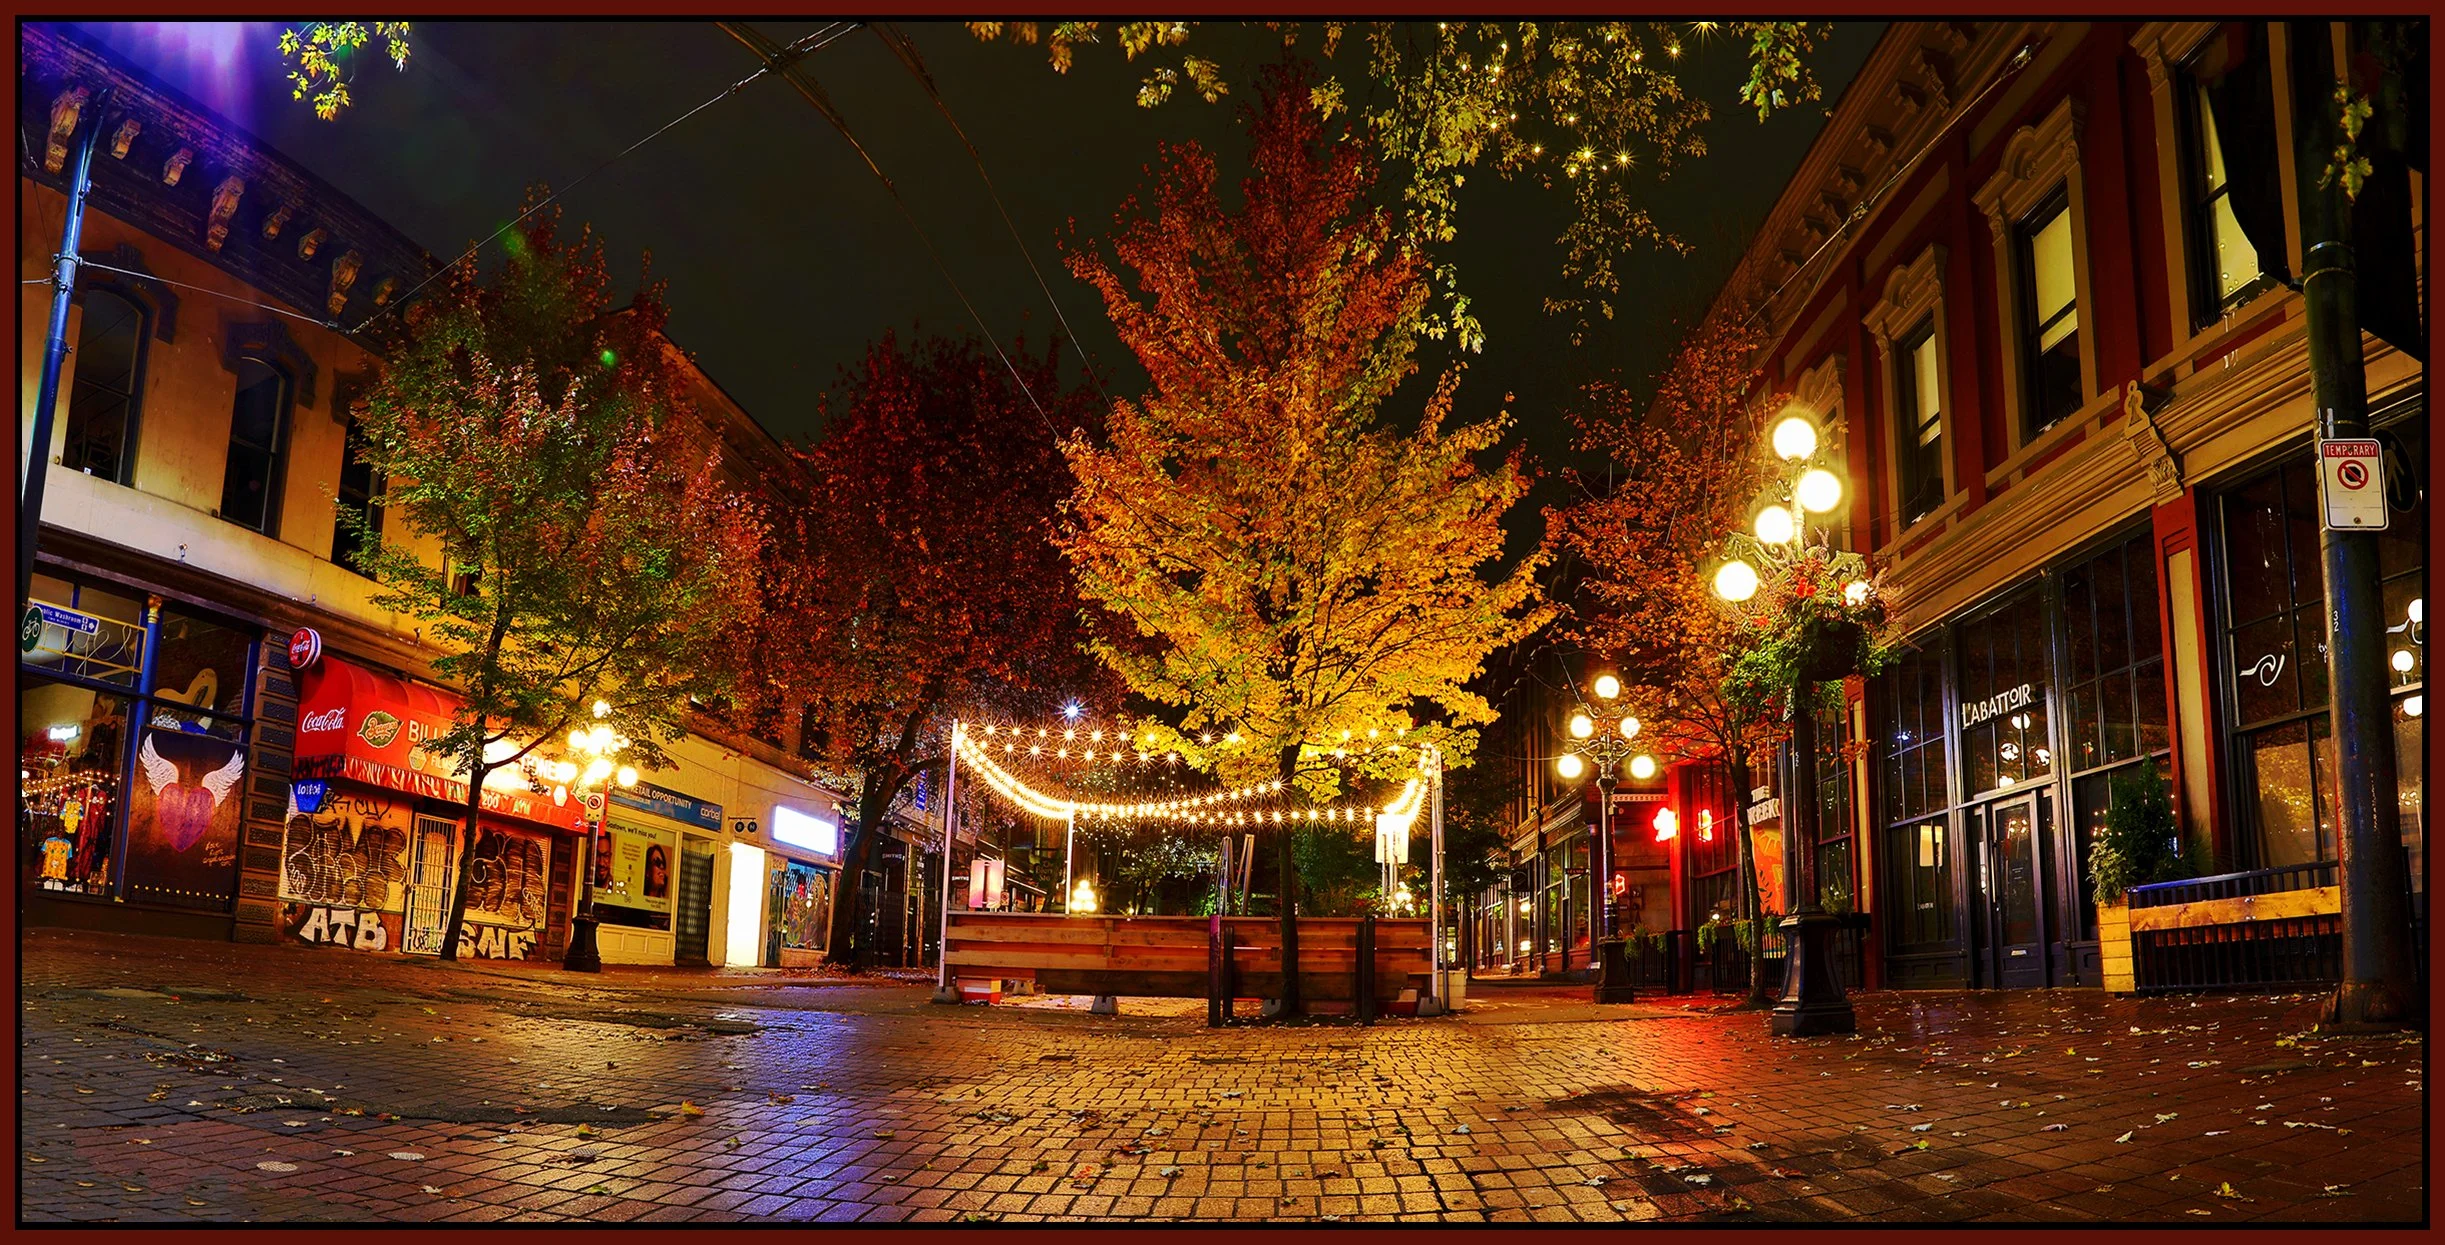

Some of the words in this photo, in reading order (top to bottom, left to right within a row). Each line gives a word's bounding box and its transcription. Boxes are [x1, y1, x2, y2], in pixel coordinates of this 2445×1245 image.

[2325, 444, 2375, 456] TEMPORARY
[55, 611, 81, 623] Washroom
[1961, 683, 2032, 730] L'ABATTOIR
[651, 790, 693, 810] OPPORTUNITY
[1746, 798, 1781, 826] REEK
[299, 907, 388, 951] ATB
